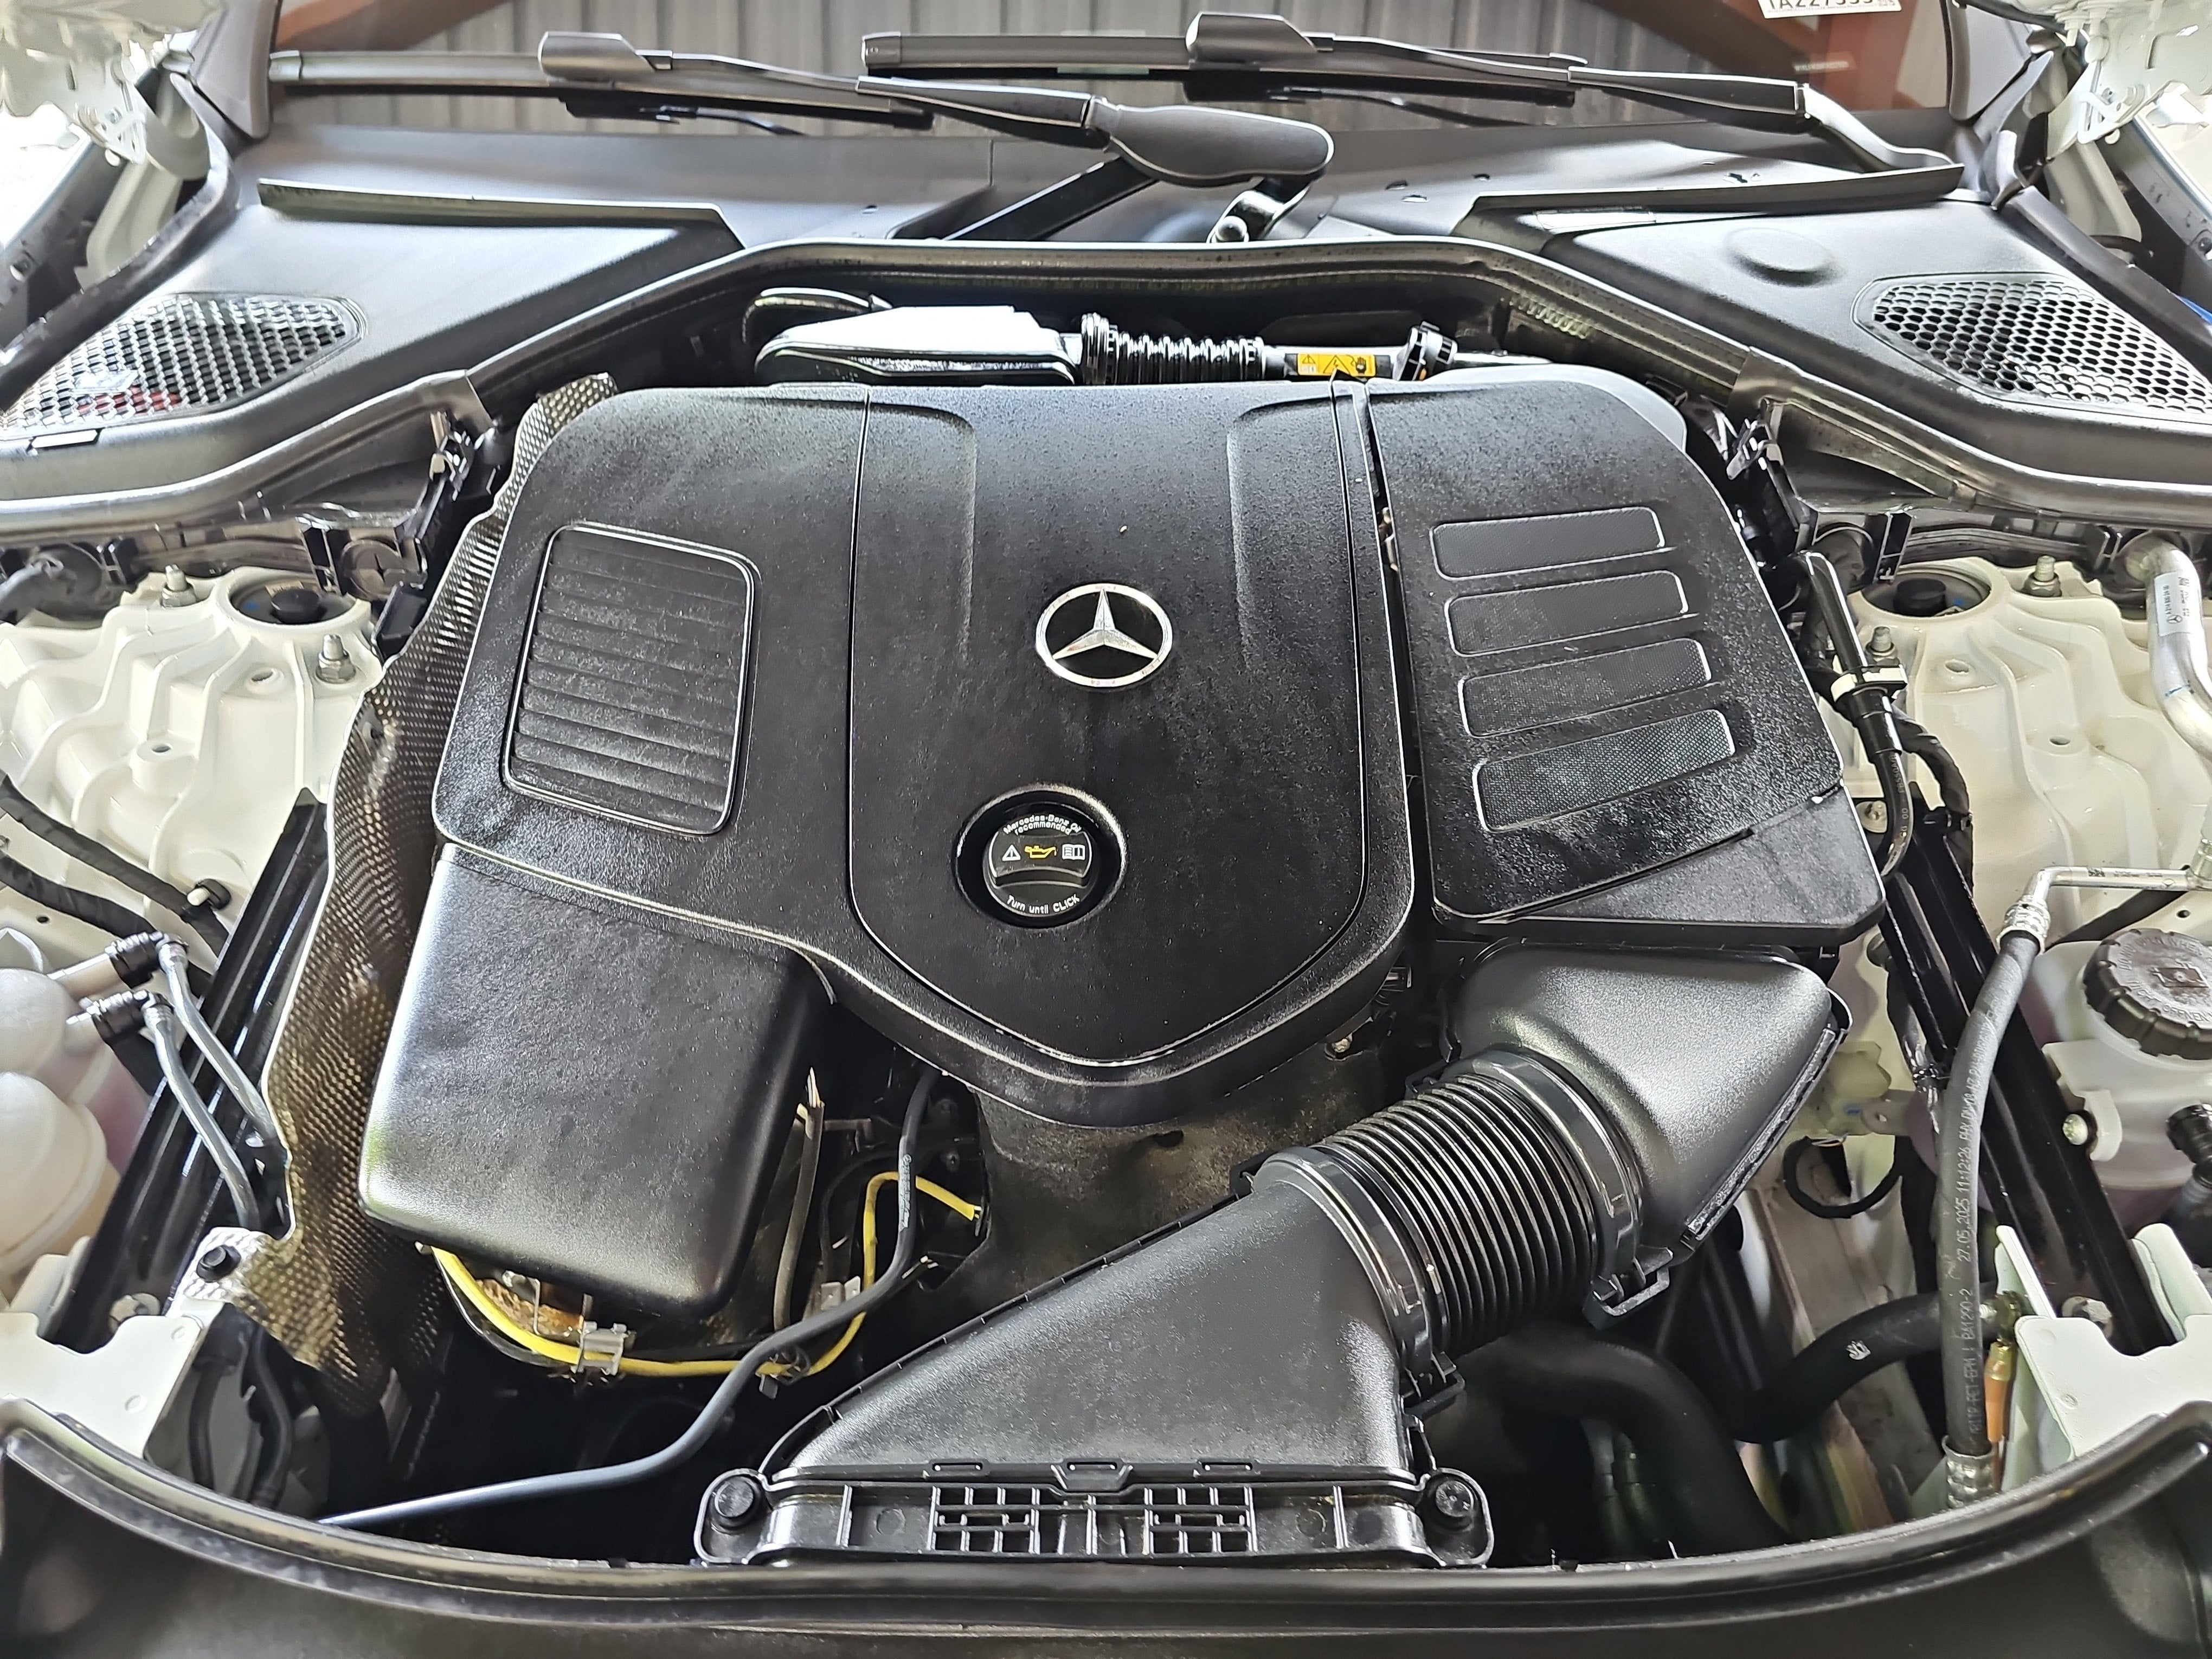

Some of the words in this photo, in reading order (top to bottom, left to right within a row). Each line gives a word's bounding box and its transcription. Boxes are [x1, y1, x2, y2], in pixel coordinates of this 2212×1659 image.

[1004, 814, 1069, 834] Mercedes-Benz
[1070, 822, 1082, 833] Oil
[1014, 821, 1072, 835] recommended
[1006, 895, 1026, 911] Turn
[1029, 903, 1049, 914] until
[1053, 893, 1080, 912] CLICK
[1955, 1146, 1972, 1194] 11:12:26
[1956, 1197, 1972, 1263] 27.05.2025
